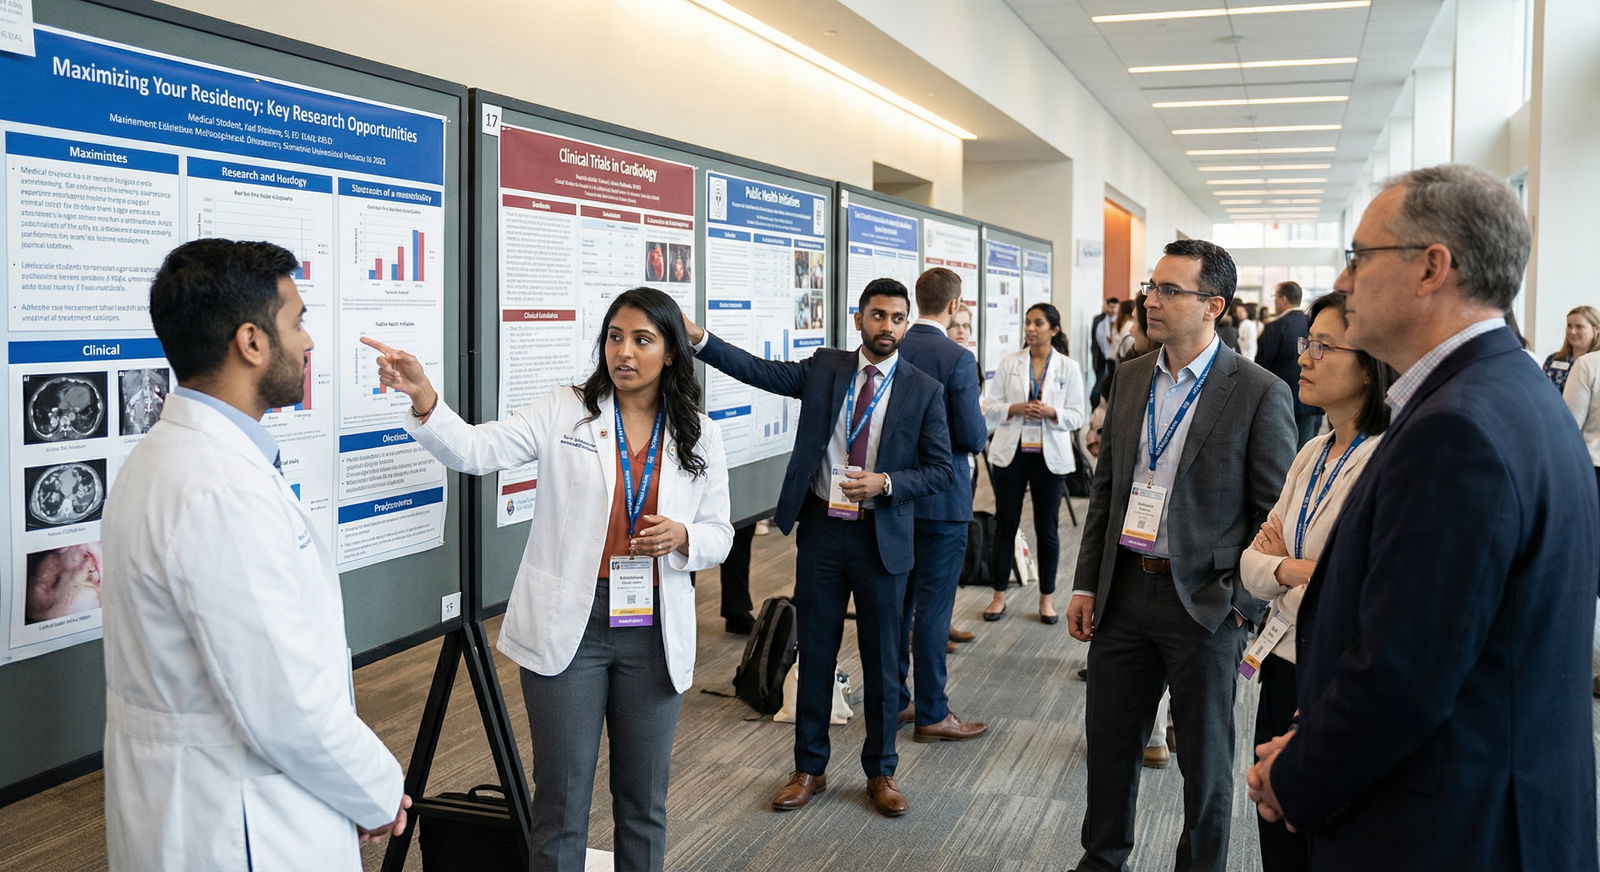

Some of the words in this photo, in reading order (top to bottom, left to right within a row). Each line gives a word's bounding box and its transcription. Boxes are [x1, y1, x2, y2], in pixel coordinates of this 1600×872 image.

[52, 56, 149, 96] Maximizing
[152, 76, 187, 99] Your
[191, 84, 264, 116] Residency:
[267, 99, 290, 122] Key
[293, 104, 345, 129] Research
[347, 116, 418, 143] Opportunities
[188, 113, 215, 125] Medical
[485, 112, 498, 128] 17
[20, 166, 47, 176] Medical
[559, 147, 589, 168] Clinical
[590, 154, 611, 171] Trials
[612, 158, 619, 173] in
[620, 160, 657, 183] Cardiology
[222, 167, 259, 181] Research
[260, 173, 275, 182] and
[745, 185, 762, 200] Public
[762, 189, 778, 203] Health
[82, 344, 120, 356] Clinical
